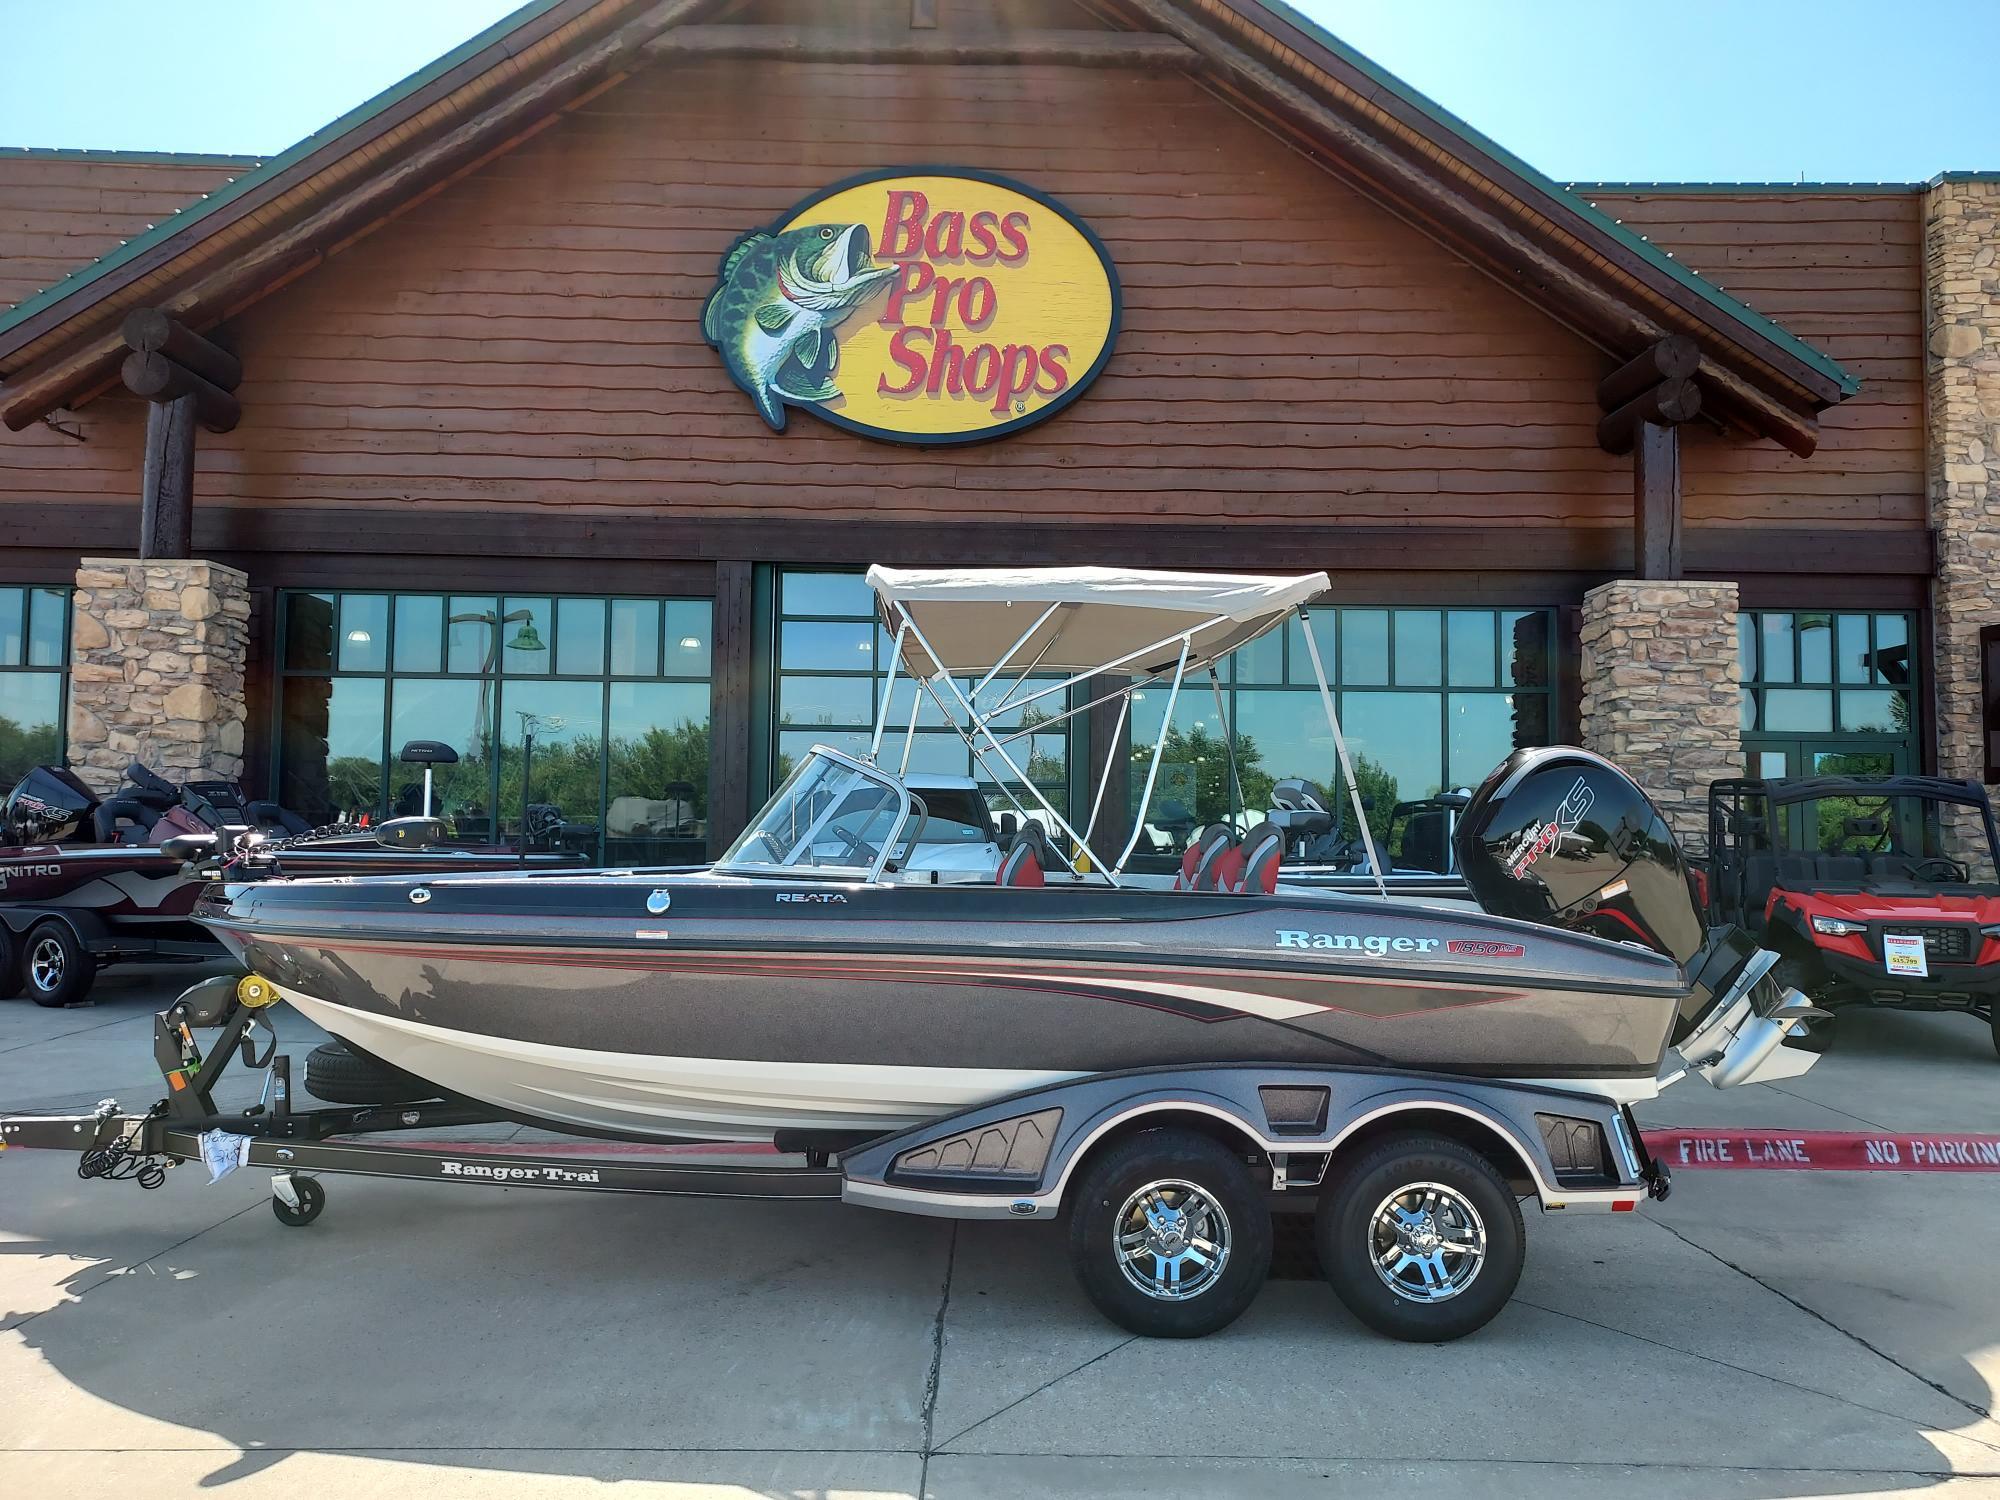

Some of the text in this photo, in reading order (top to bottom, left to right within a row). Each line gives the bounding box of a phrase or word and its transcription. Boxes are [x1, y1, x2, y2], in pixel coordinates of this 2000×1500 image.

[873, 190, 1029, 261] Bass
[877, 261, 997, 326] Pro
[877, 325, 1069, 413] Shops
[1506, 820, 1541, 866] MERCURY
[1513, 822, 1559, 880] PRO
[5, 864, 62, 878] NITRO
[775, 893, 848, 903] REATA
[1275, 930, 1439, 957] Ranger
[1679, 1140, 1734, 1164] FIRE
[1747, 1139, 1811, 1163] LANE
[1864, 1140, 1900, 1164] NO
[441, 1162, 539, 1180] Ranger
